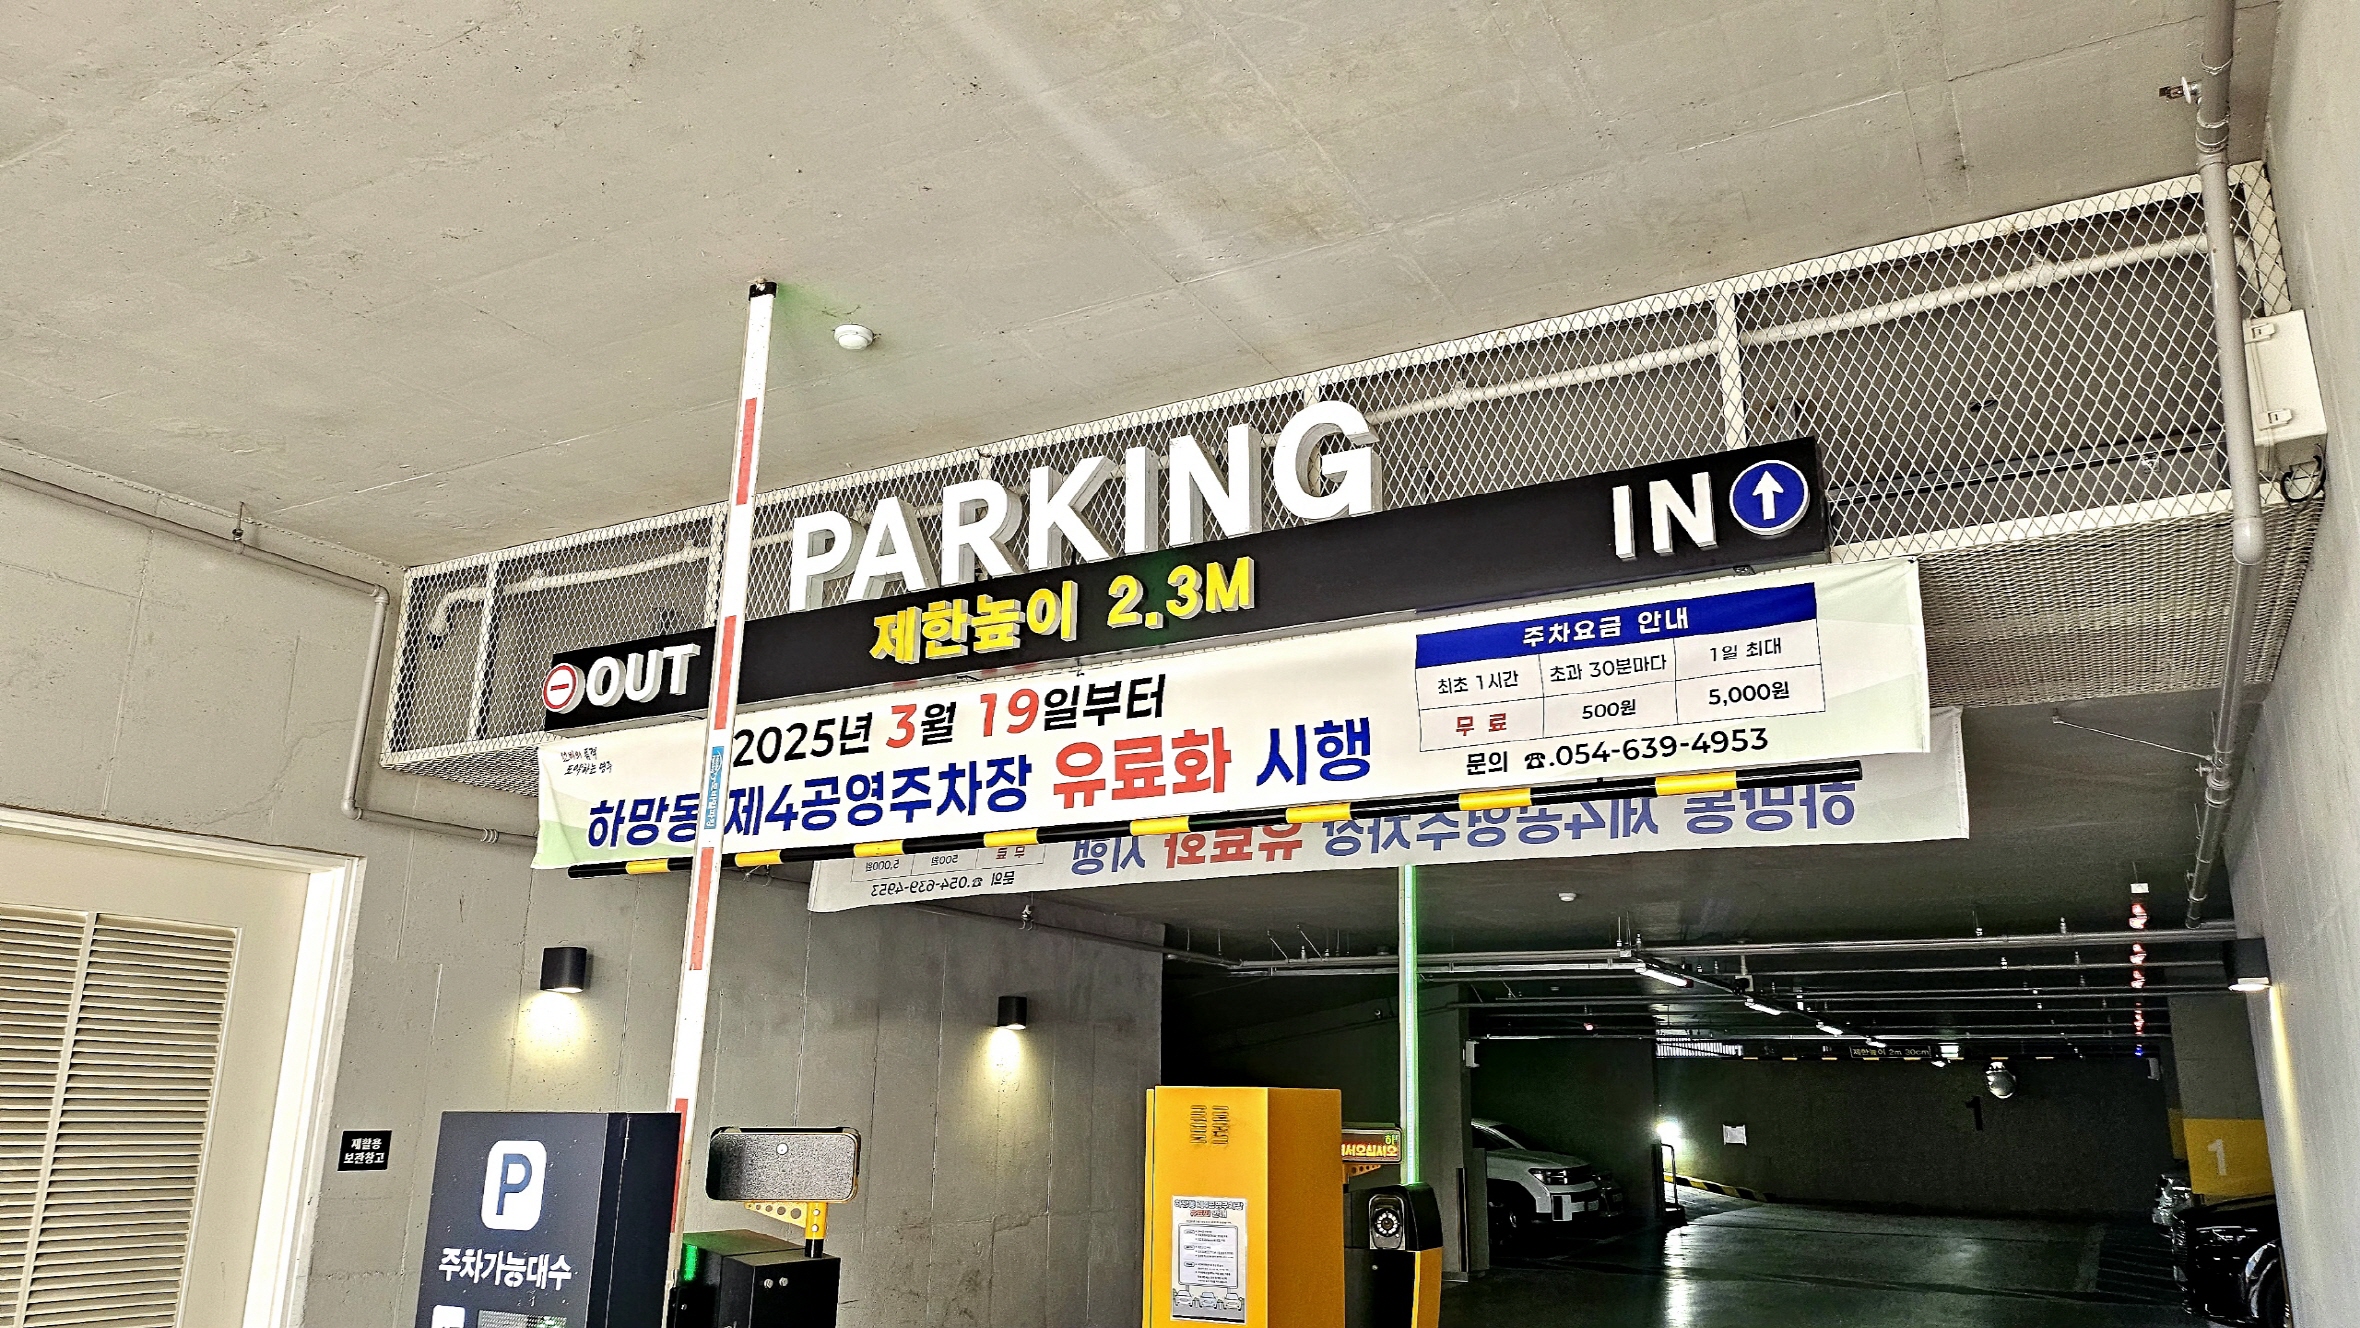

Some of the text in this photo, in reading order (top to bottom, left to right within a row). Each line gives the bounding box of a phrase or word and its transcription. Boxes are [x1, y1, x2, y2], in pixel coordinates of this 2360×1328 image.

[789, 400, 1380, 612] PARKING
[1612, 472, 1717, 559] IN
[870, 555, 1255, 664] 제한높이 2.3M
[1523, 607, 1688, 647] 주차요금 안내
[1550, 654, 1667, 683] 초과 30분마다
[1710, 637, 1782, 661] 1일 최대
[587, 643, 700, 707] OUT
[1438, 670, 1519, 694] 최초 1시간
[1708, 681, 1790, 706] 5,000원
[732, 674, 1165, 767] 2025년 3월 19일부터
[1582, 699, 1636, 719] 500원
[588, 792, 700, 847] 하망동
[724, 753, 1032, 836] 제4공영주차장
[1053, 727, 1231, 809] 유료화
[1256, 717, 1371, 786] 시행
[1467, 750, 1508, 775] 문의
[343, 1151, 385, 1165] 보관창고
[351, 1137, 383, 1151] 재활용
[2208, 1138, 2227, 1176] 1
[495, 1153, 532, 1216] P
[438, 1247, 572, 1290] 주차가능대수
